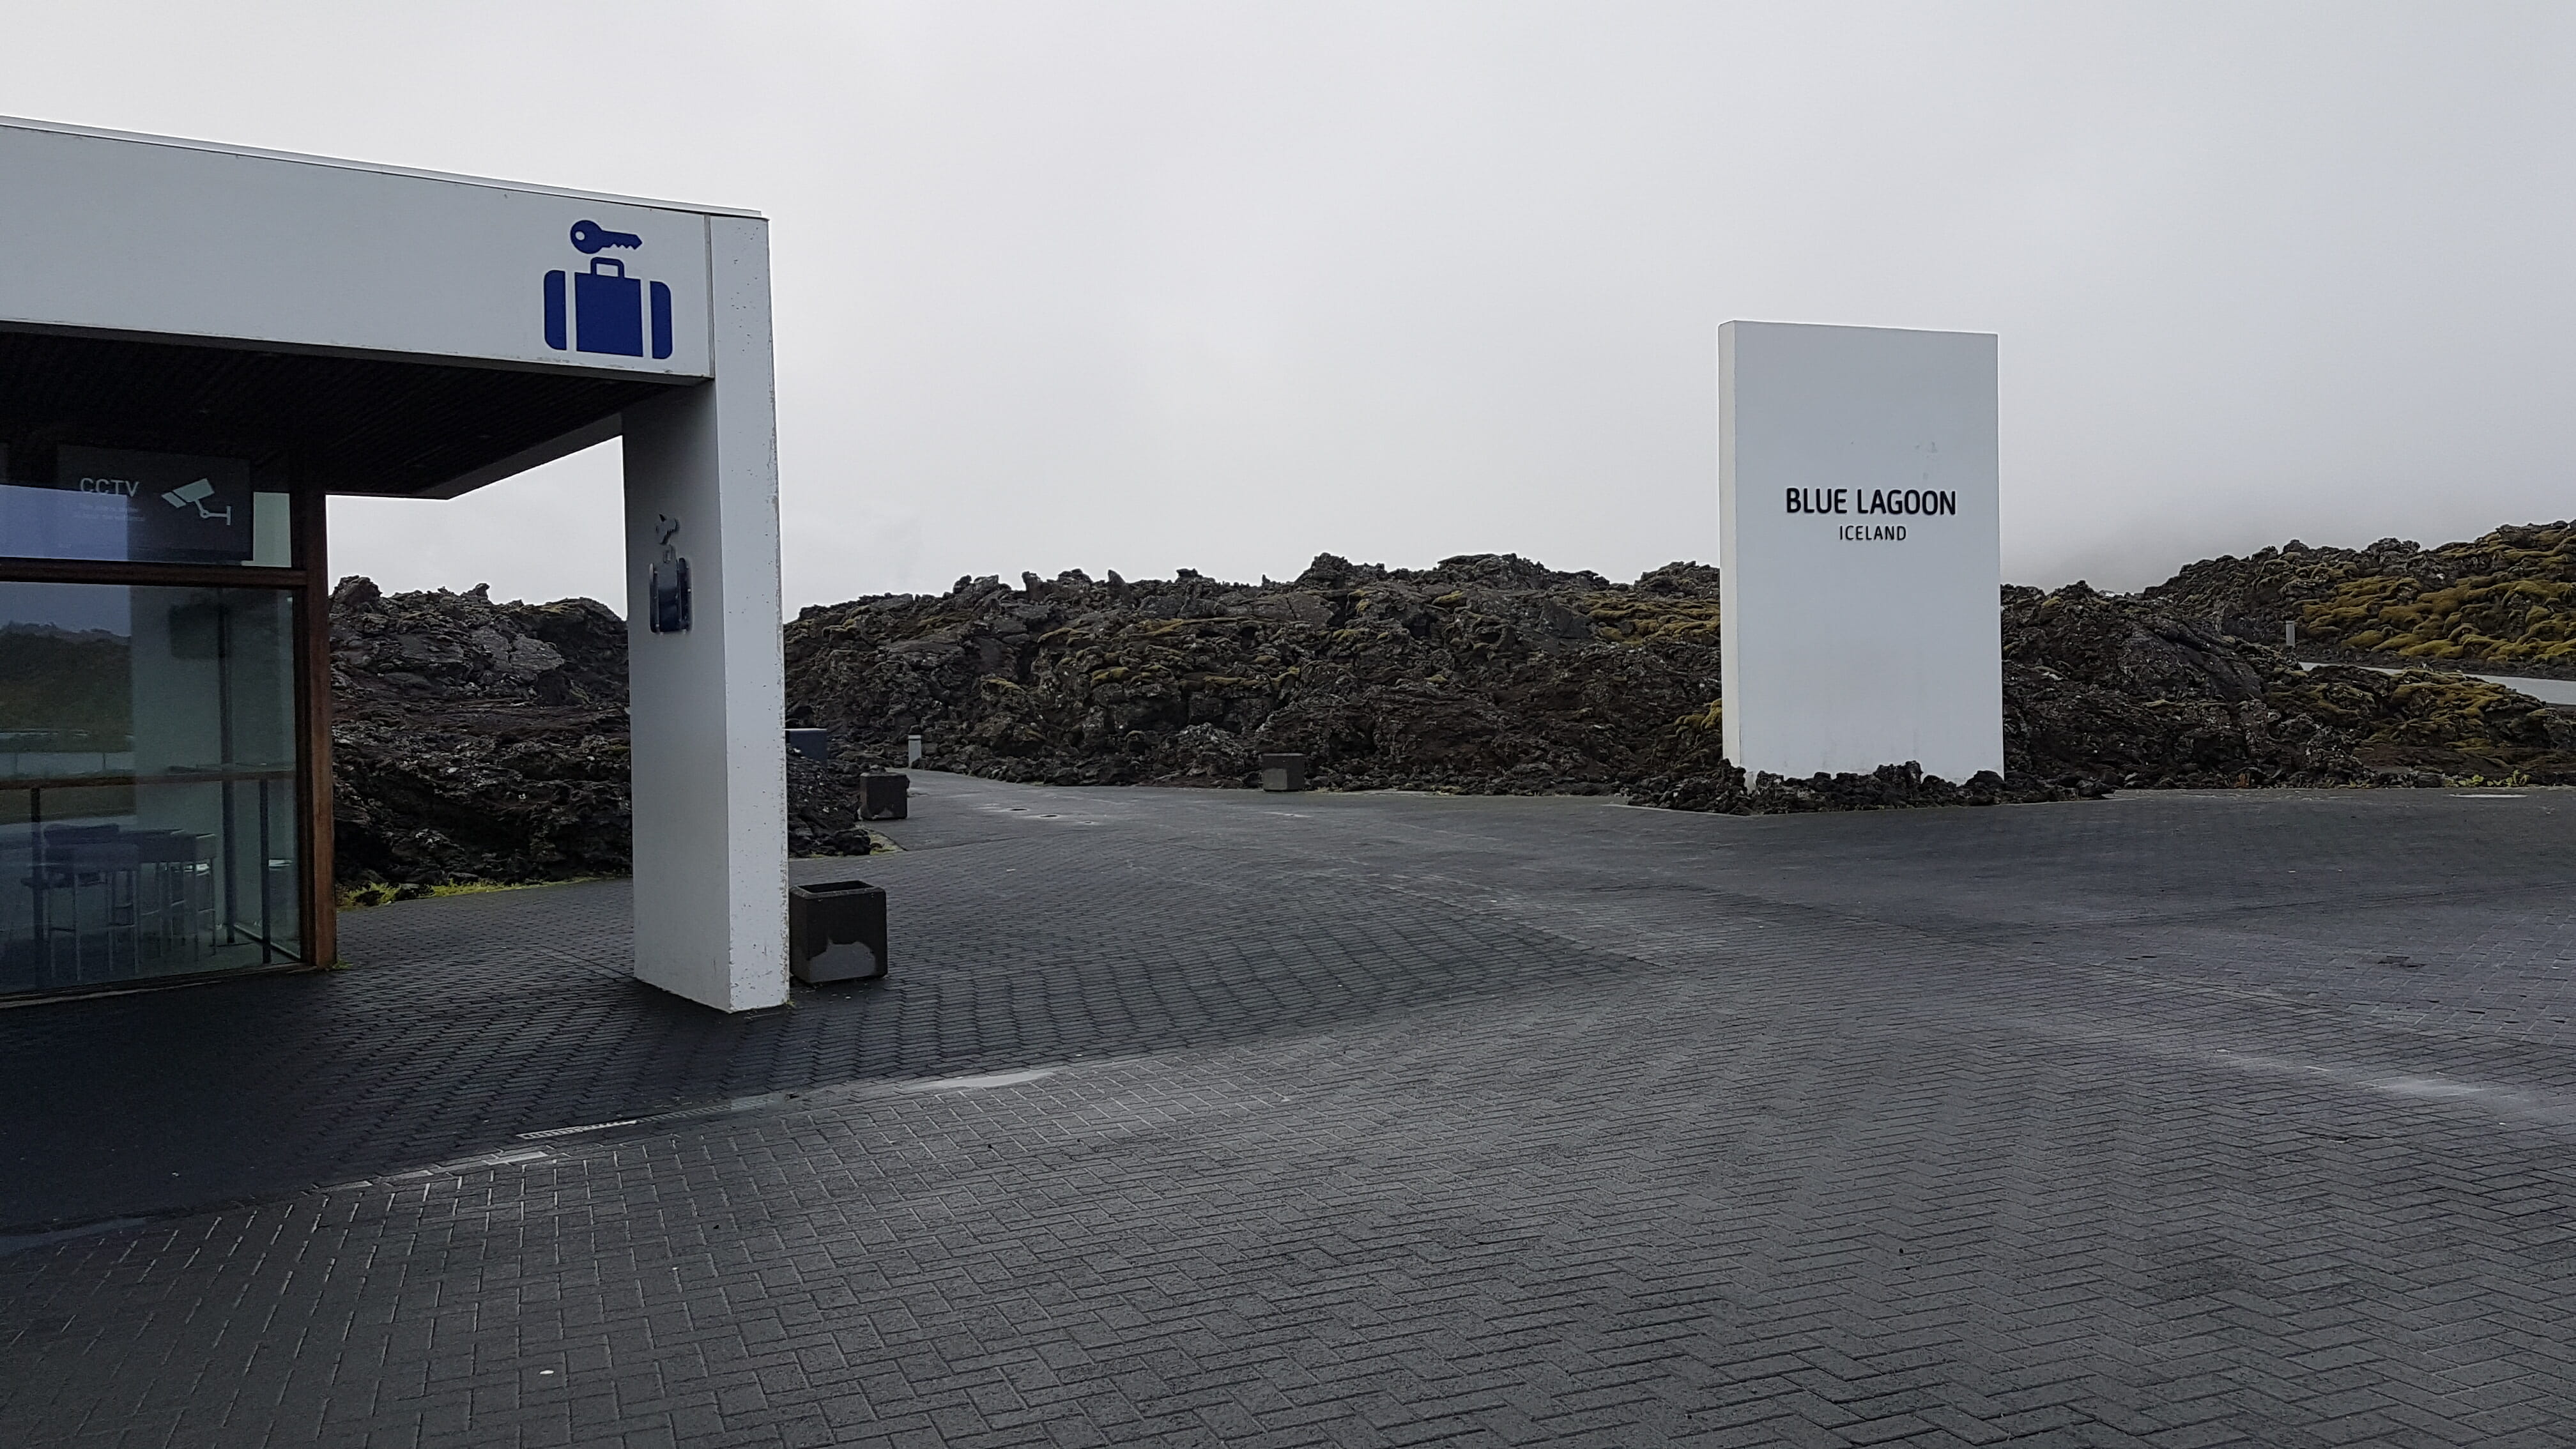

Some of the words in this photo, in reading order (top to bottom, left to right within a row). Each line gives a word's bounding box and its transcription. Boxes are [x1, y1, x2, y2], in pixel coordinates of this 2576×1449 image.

[79, 477, 140, 497] CCTV
[1786, 487, 1848, 514] BLUE
[1857, 489, 1956, 515] LAGOON
[1839, 525, 1907, 540] ICELAND
